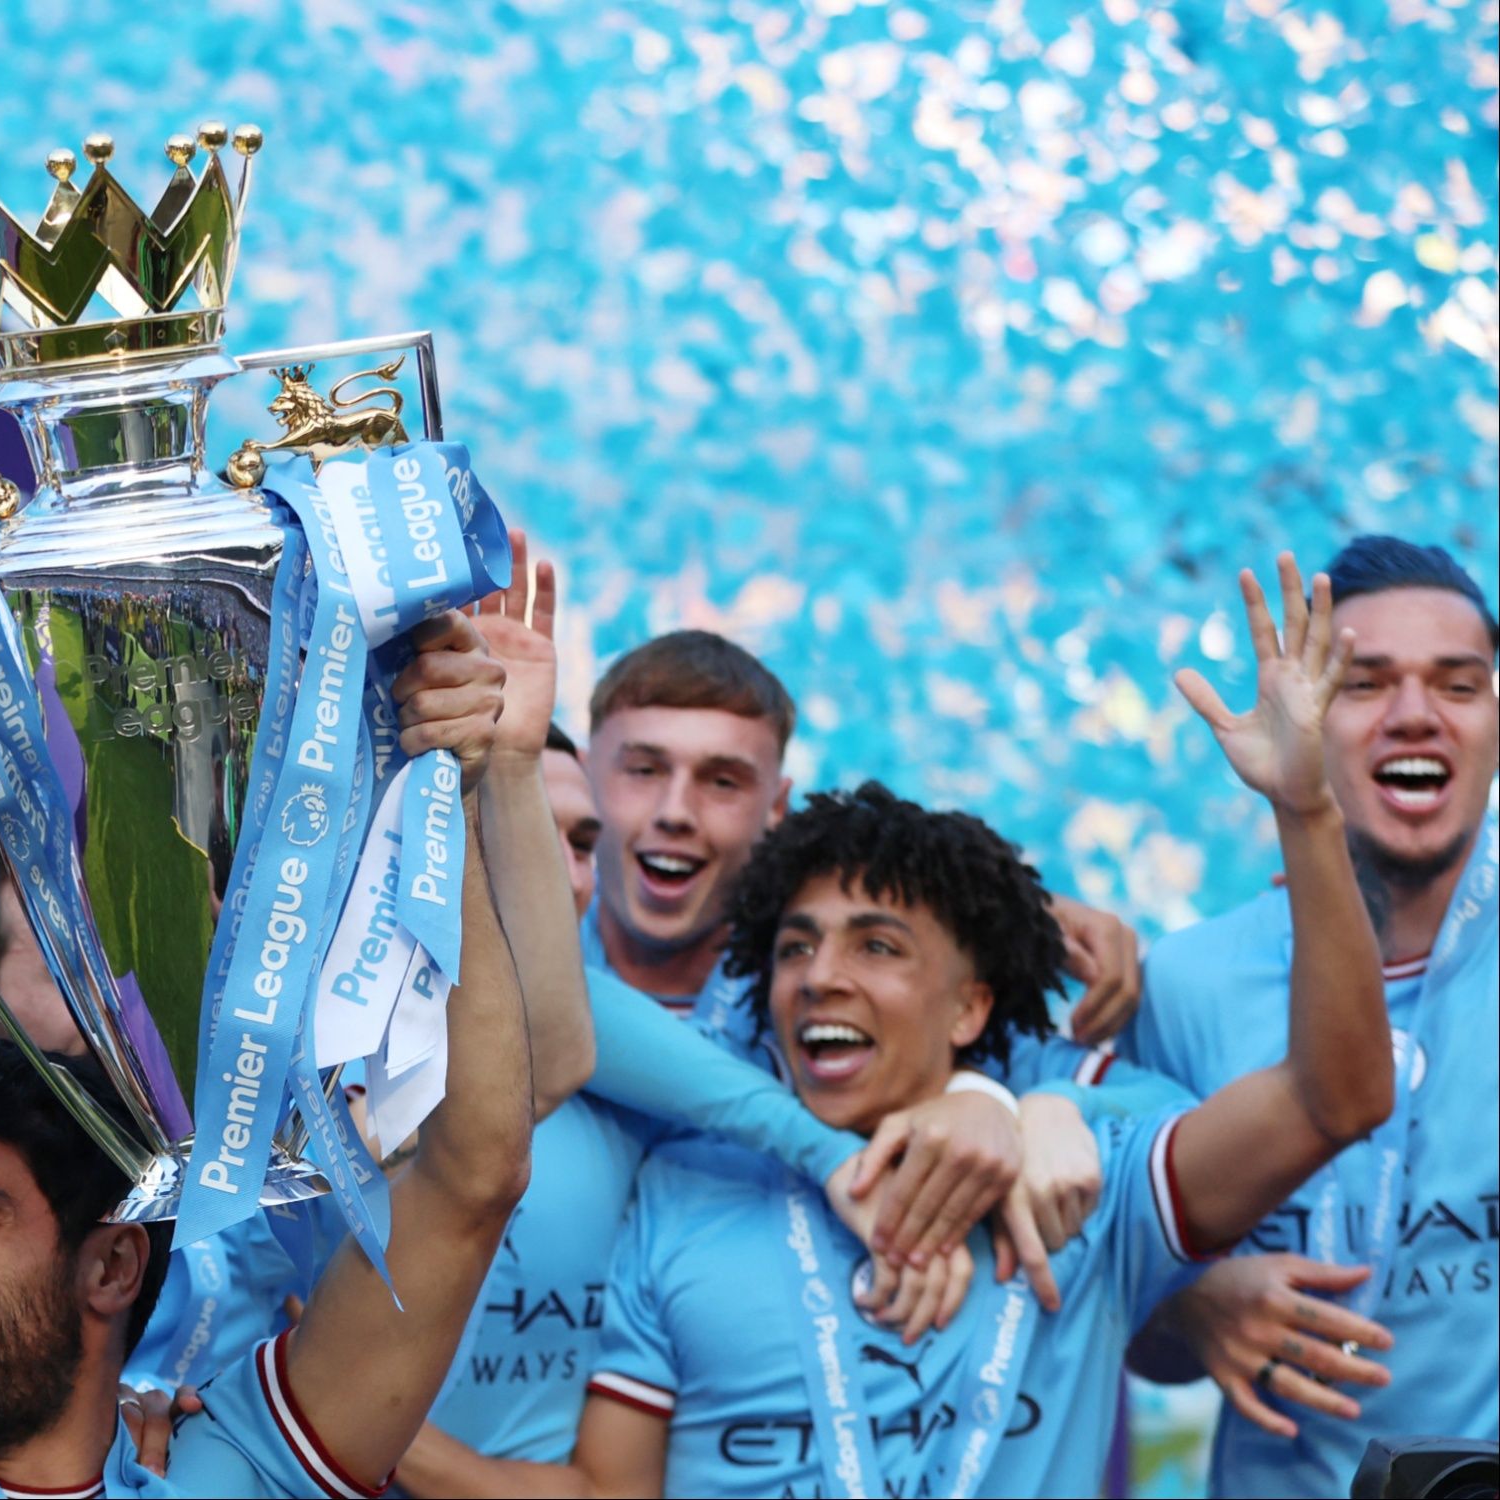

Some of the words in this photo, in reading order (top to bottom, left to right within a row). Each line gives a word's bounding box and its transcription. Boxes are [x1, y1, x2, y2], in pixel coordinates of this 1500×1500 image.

[393, 457, 448, 589] League
[233, 856, 309, 1026] League
[297, 603, 356, 773] Premier
[410, 748, 460, 906] Premier
[199, 1030, 268, 1196] Premier
[472, 1348, 578, 1386] WAYS
